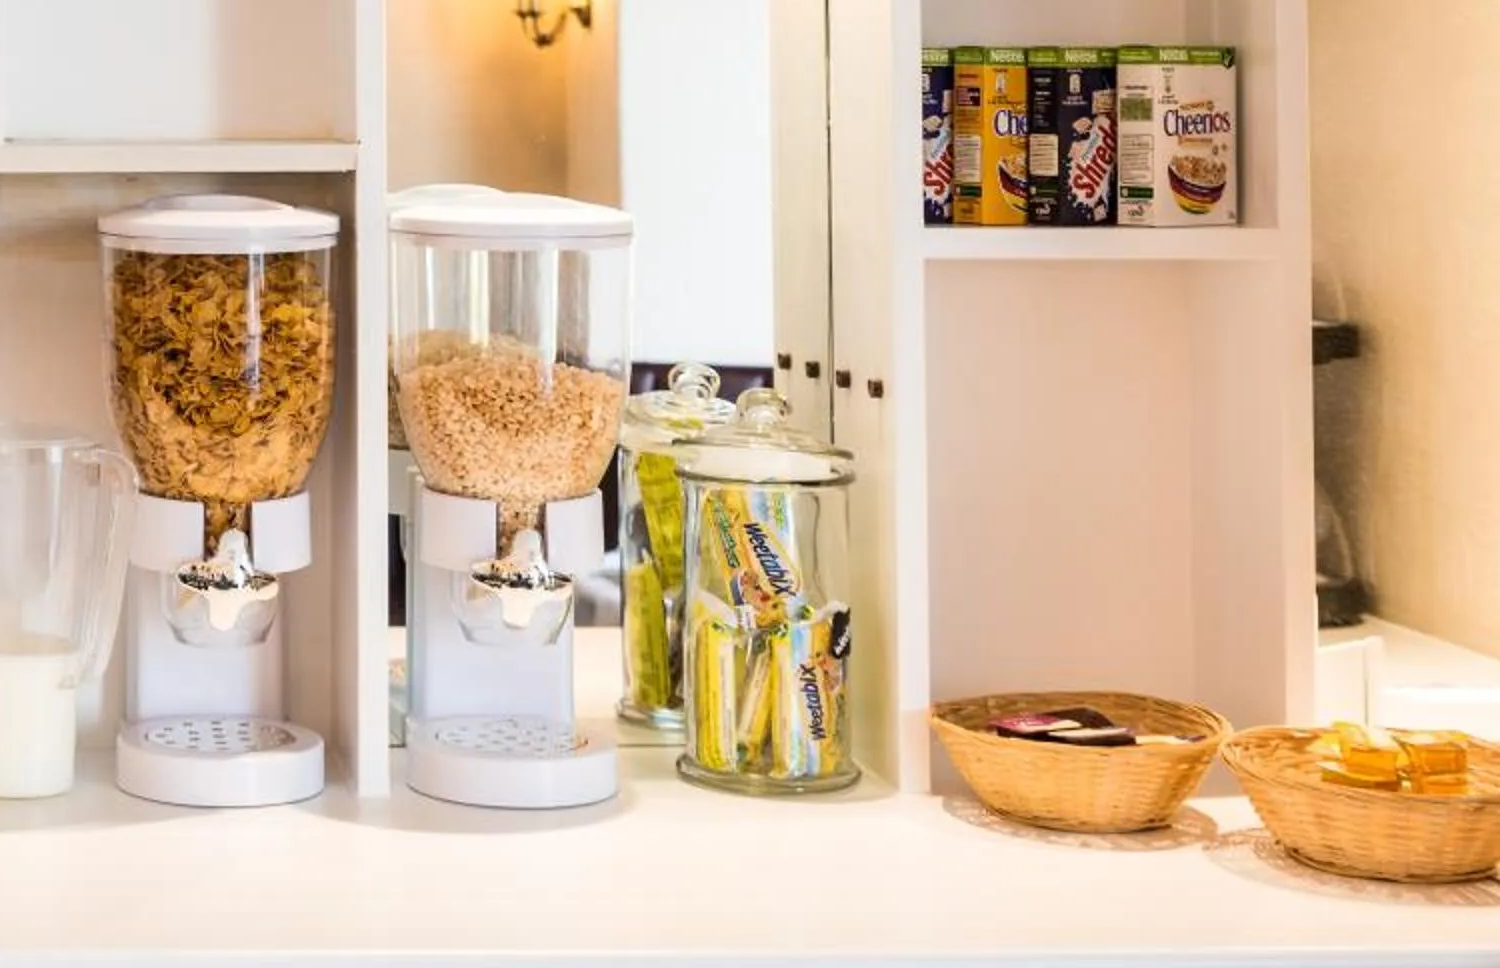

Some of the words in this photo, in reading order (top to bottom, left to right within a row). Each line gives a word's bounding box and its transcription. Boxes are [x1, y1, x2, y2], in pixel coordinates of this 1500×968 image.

[1163, 108, 1231, 137] Cheerios
[743, 521, 798, 597] Weetabix
[800, 663, 827, 741] Weetabix
